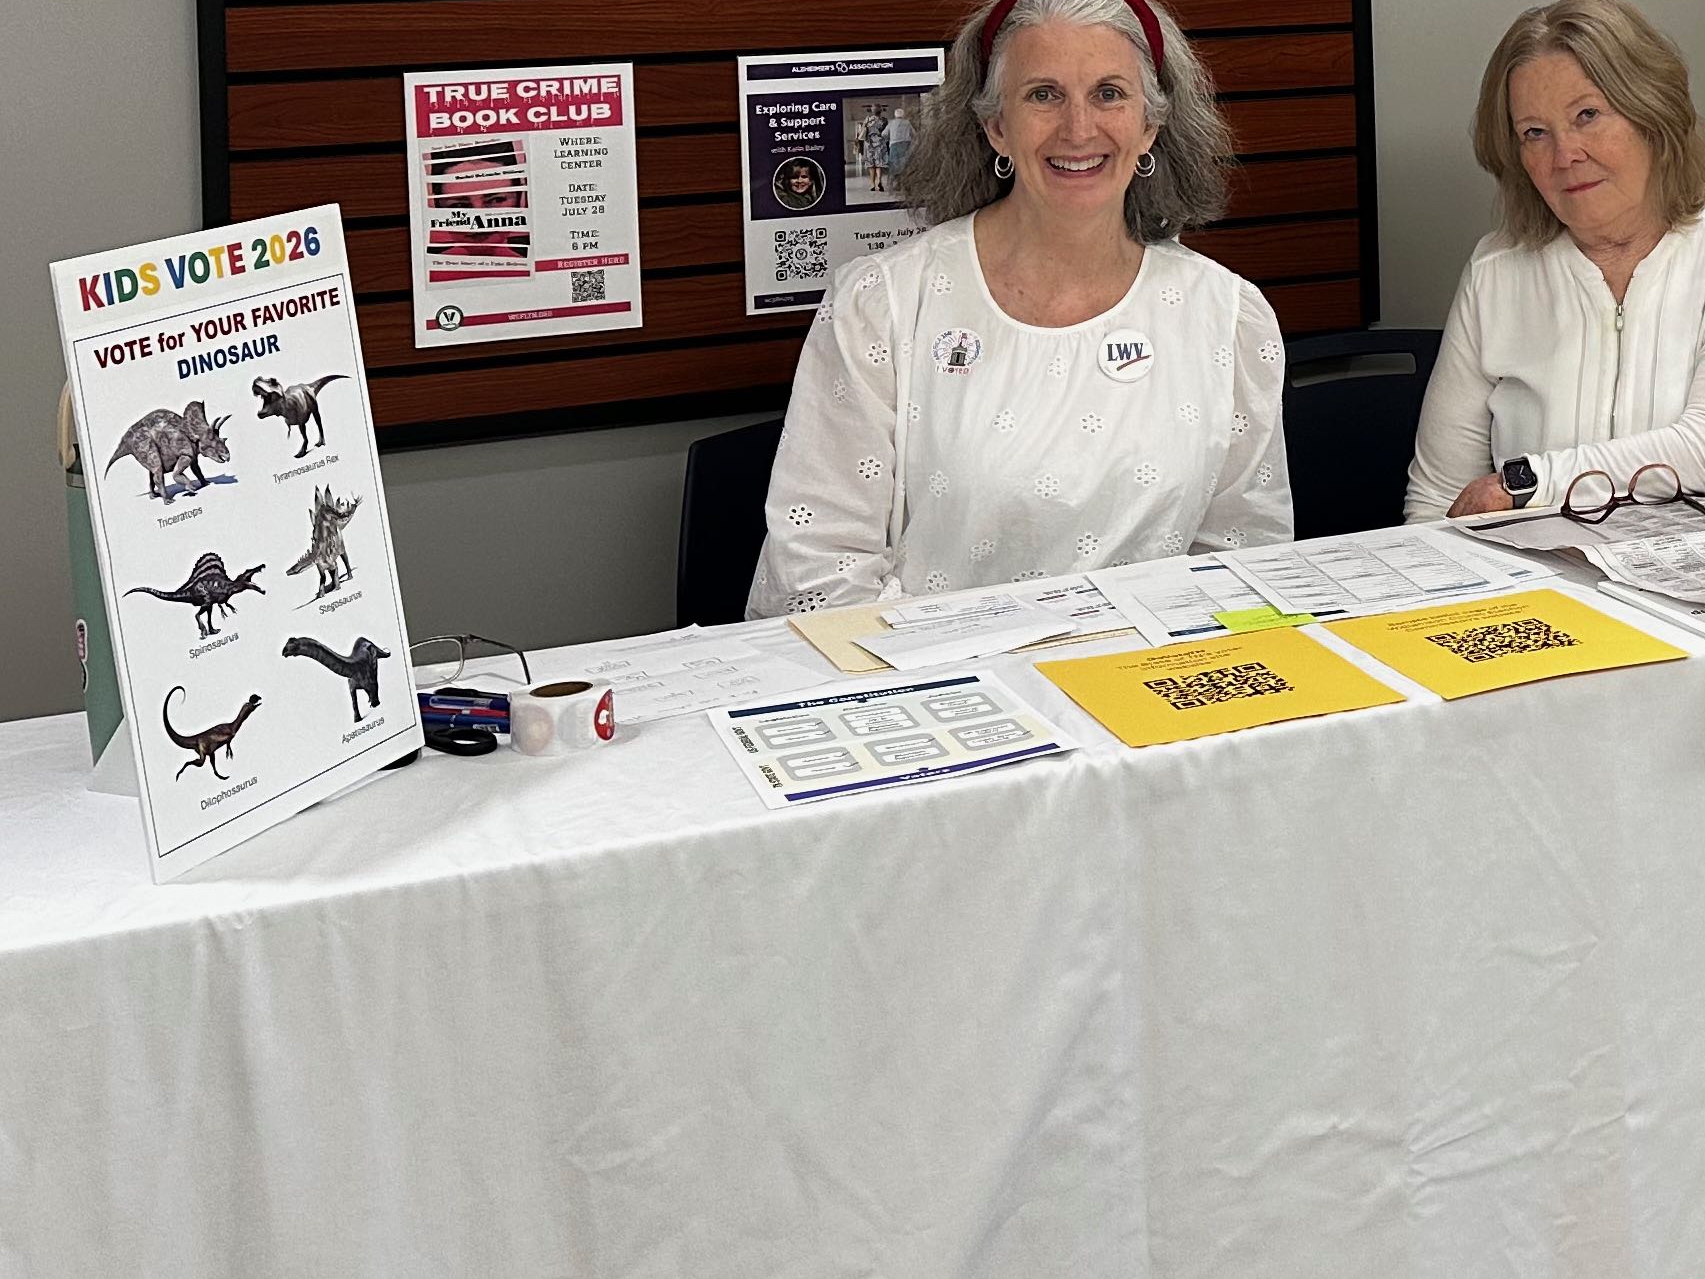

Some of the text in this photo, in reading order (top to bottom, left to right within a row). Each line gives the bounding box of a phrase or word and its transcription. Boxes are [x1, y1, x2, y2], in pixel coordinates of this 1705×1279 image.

[791, 62, 894, 73] ALZHEIMER'S ASSOCIATION
[424, 77, 620, 105] TRUE CRIME
[755, 102, 837, 115] Exploring Care
[428, 103, 612, 130] BOOK CLUB
[769, 115, 825, 128] & Support
[774, 130, 821, 142] Services
[553, 148, 609, 158] LEARNING
[560, 159, 603, 169] CENTER
[559, 194, 606, 205] TUESDAY
[451, 211, 468, 220] My
[562, 205, 605, 216] JULY 28
[430, 215, 527, 229] Friend Anna
[897, 229, 914, 238] July
[582, 241, 599, 250] PM
[78, 226, 321, 312] KIDS VOTE 2026
[557, 256, 625, 269] REGISTER HERE
[94, 287, 341, 369] VOTE for YOUR FAVORITE
[177, 334, 280, 380] DINOSAUR
[1106, 342, 1144, 362] LWV
[325, 453, 340, 467] Rex
[157, 507, 203, 530] Triceratops
[318, 590, 362, 614] Stegosaurus
[189, 631, 239, 659] Spinosaurus
[828, 687, 914, 703] Constitution
